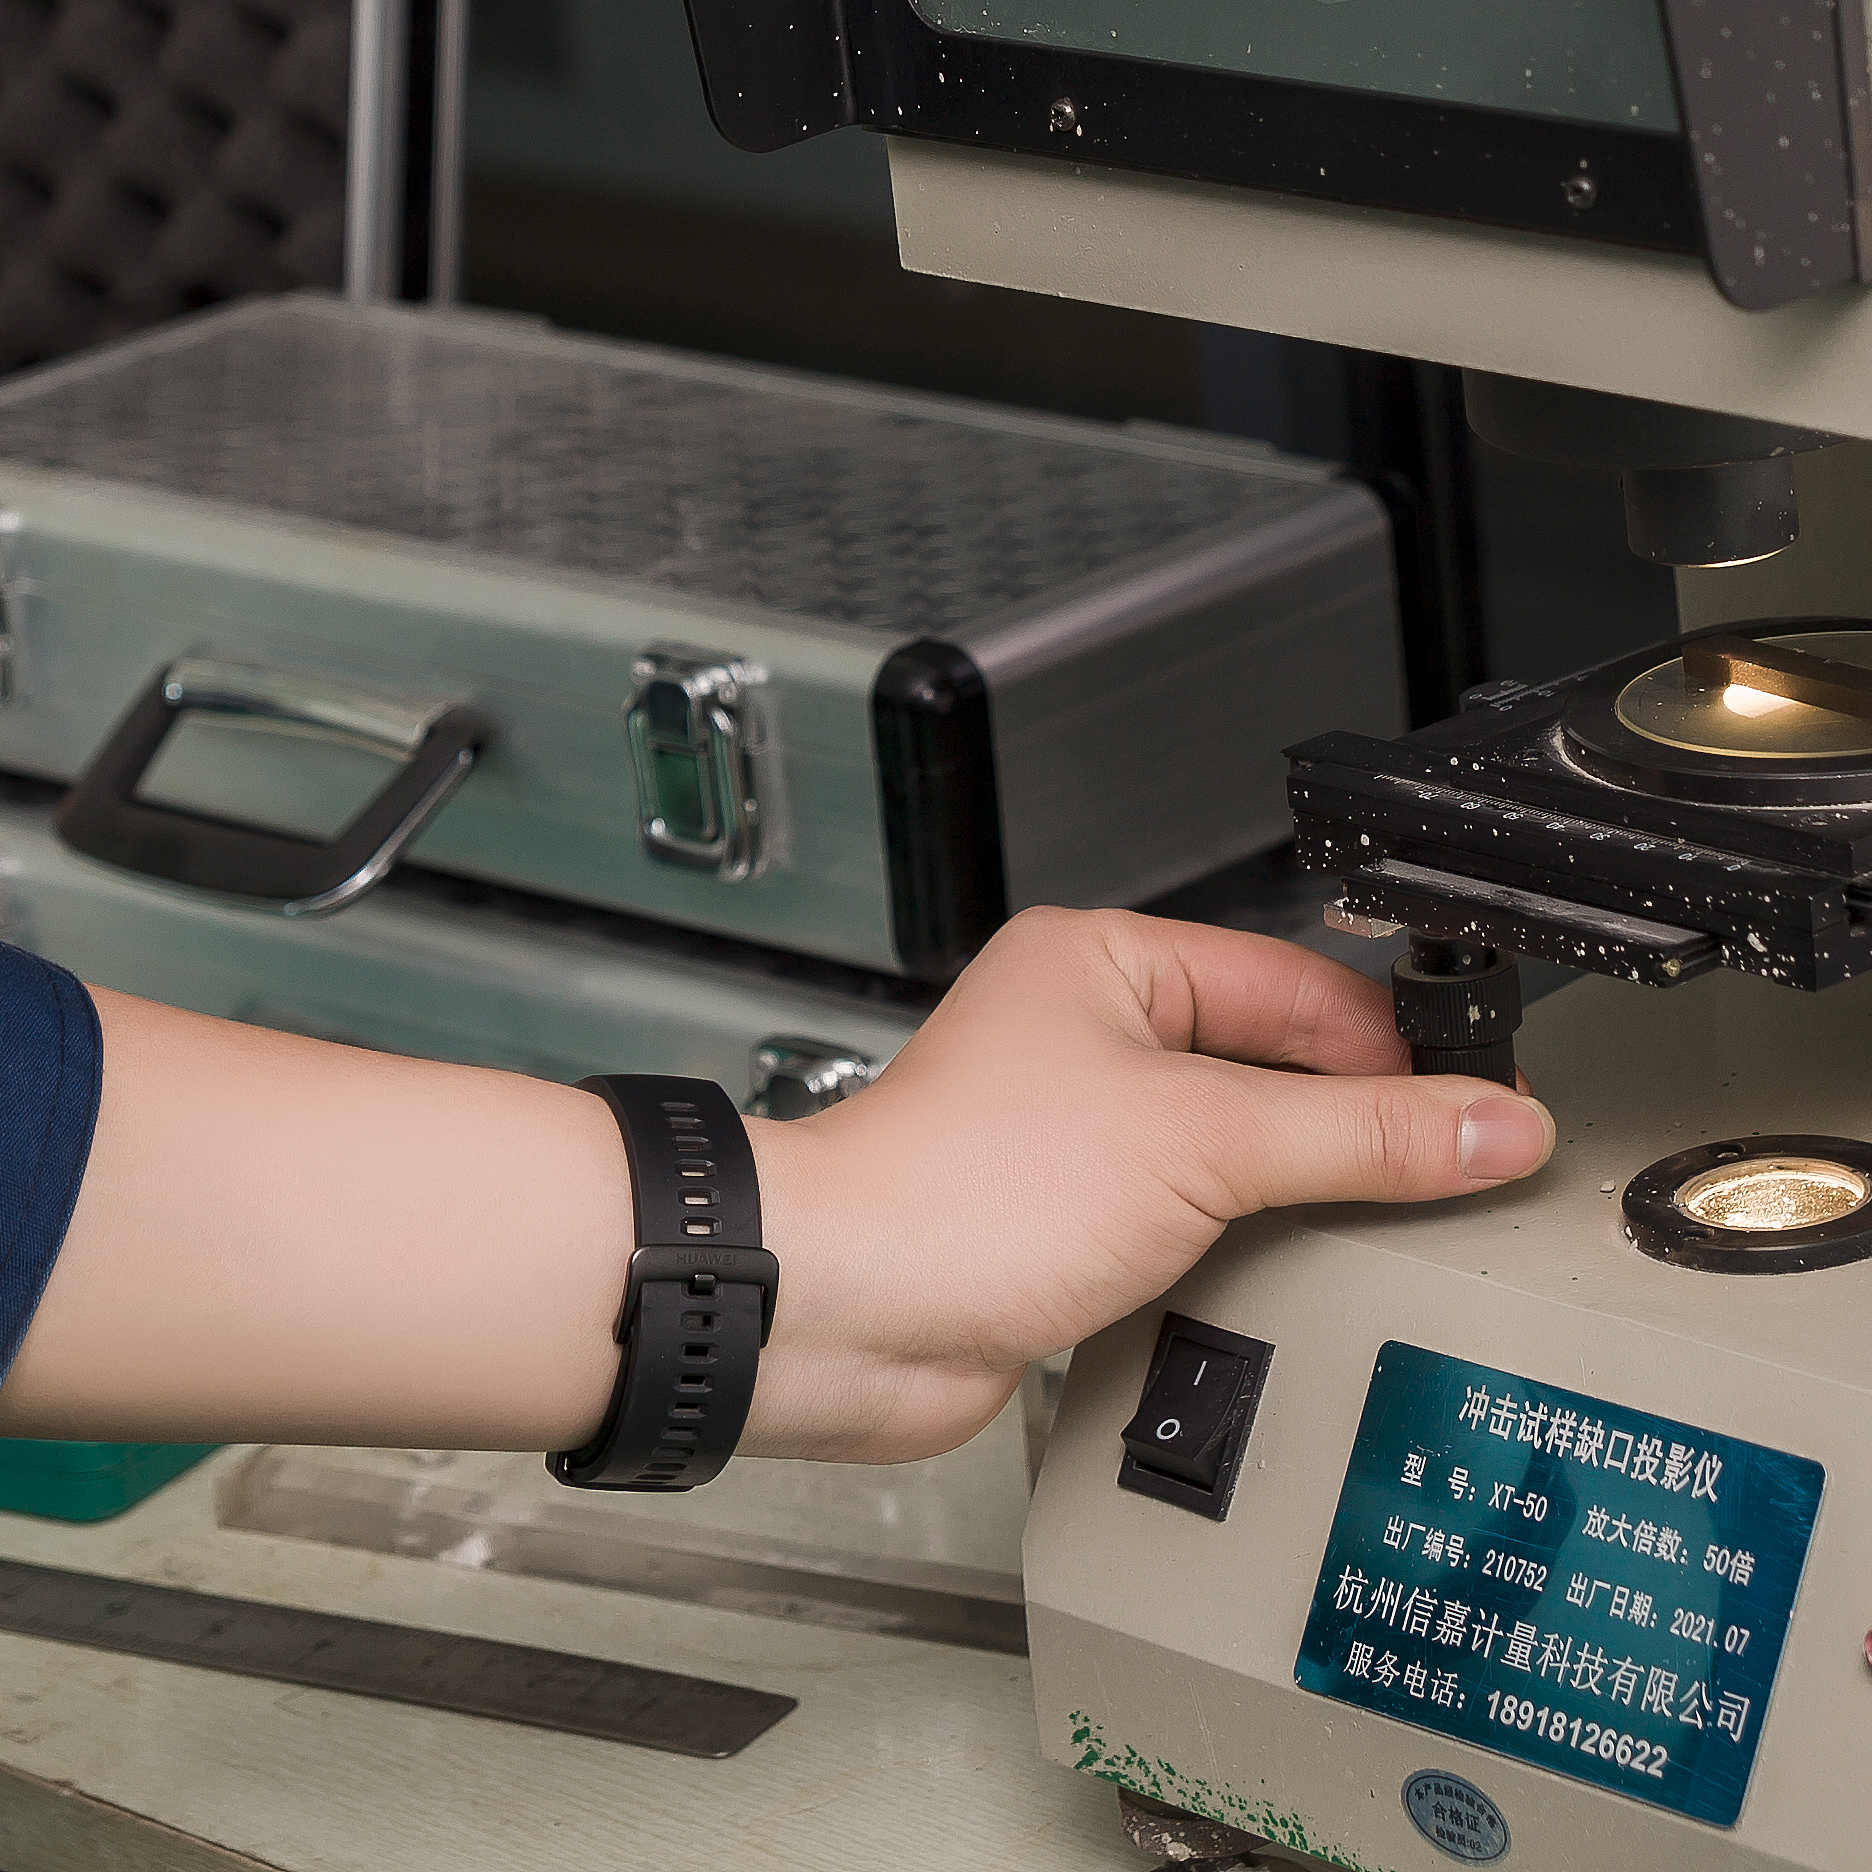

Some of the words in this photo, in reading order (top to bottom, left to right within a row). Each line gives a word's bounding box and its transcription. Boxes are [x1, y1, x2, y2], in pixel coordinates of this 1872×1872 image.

[676, 1252, 737, 1266] HUAWEI
[1458, 1384, 1723, 1503] 冲击试样缺口投影仪
[1333, 1564, 1750, 1743] 杭州信嘉计量科技有限公司
[1431, 1800, 1482, 1834] 合格证
